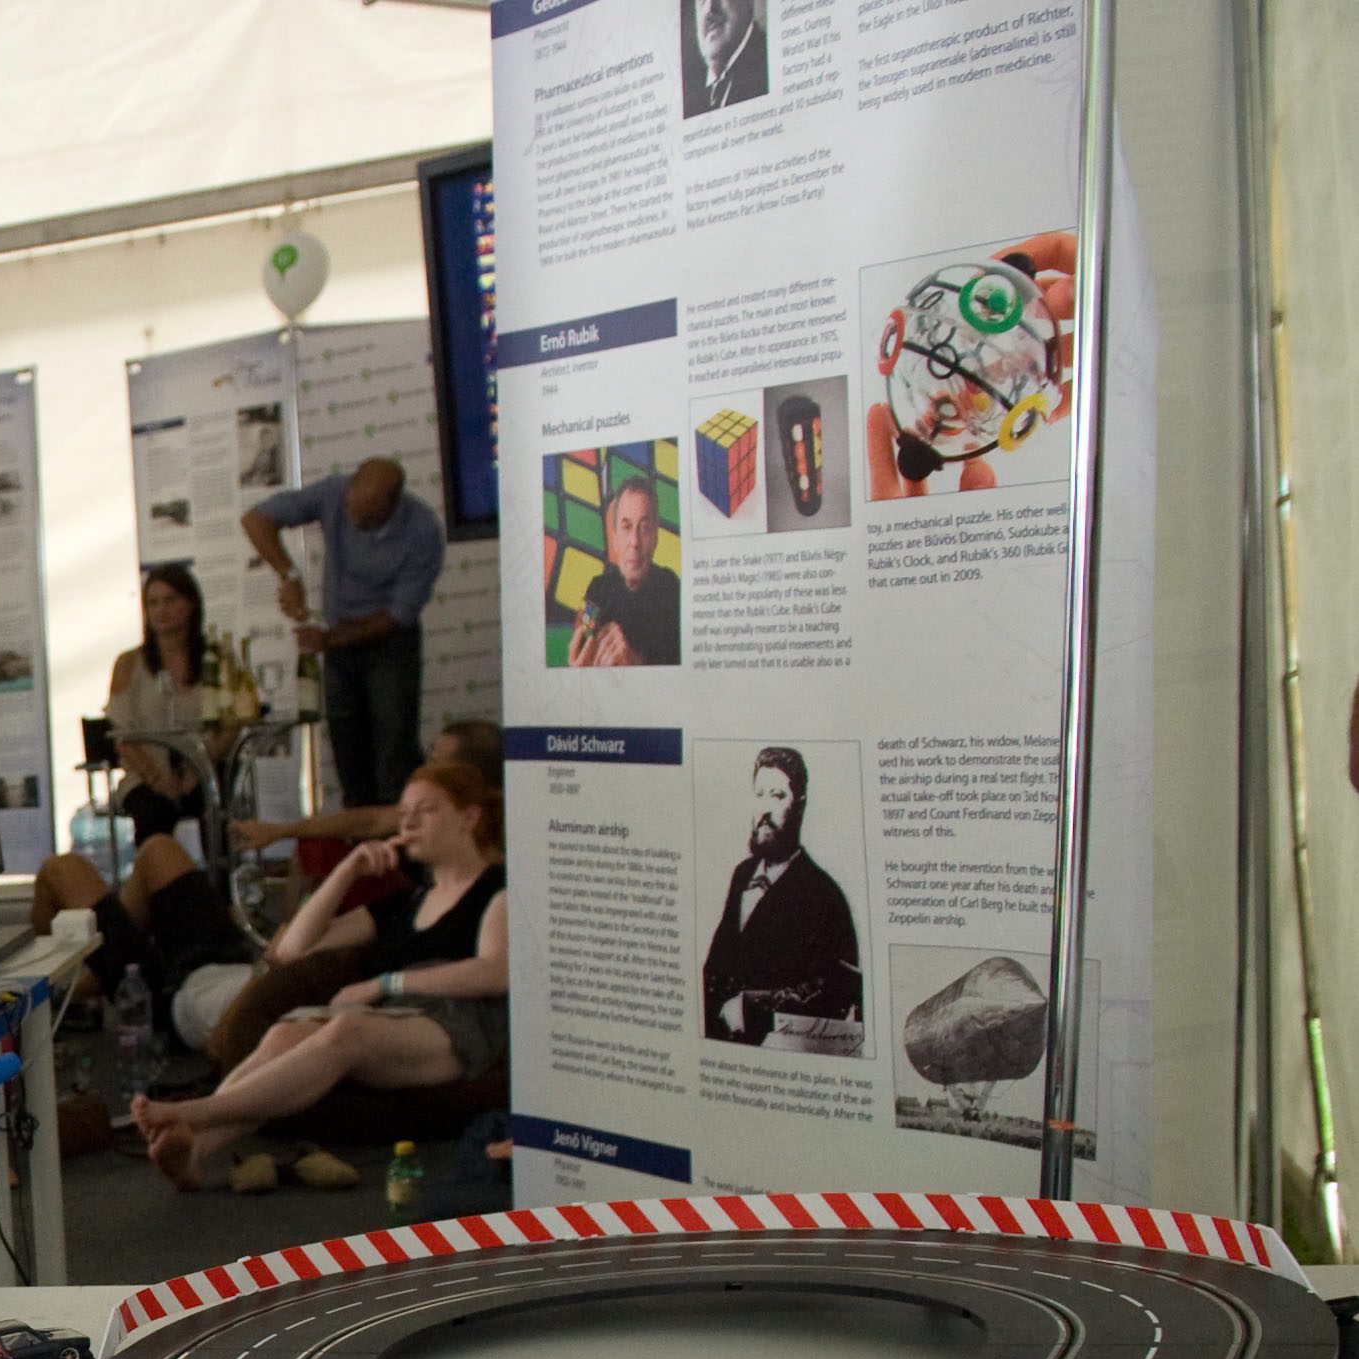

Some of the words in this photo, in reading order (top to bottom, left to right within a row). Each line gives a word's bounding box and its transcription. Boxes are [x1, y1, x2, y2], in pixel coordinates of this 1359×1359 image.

[859, 59, 872, 70] The
[874, 53, 890, 68] first
[964, 20, 1008, 44] product
[1012, 14, 1025, 30] of
[1028, 5, 1074, 25] Richter,
[971, 32, 1038, 61] (adrenaline)
[1042, 32, 1052, 44] is
[1055, 23, 1076, 40] still
[535, 70, 602, 102] Pharmaceutical
[606, 51, 654, 78] inventions
[883, 88, 909, 104] widely
[912, 80, 934, 95] used
[936, 77, 946, 89] in
[949, 67, 992, 86] modern
[995, 52, 1056, 75] medicine.
[775, 303, 788, 314] and
[540, 331, 566, 352] Ernő
[568, 324, 600, 347] Rubik
[542, 415, 594, 436] Mechanical
[597, 411, 631, 432] puzzles
[867, 524, 882, 536] toy,
[894, 514, 953, 531] mechanical
[956, 511, 994, 529] puzzle.
[997, 508, 1013, 521] His
[1016, 506, 1044, 519] other
[868, 540, 903, 553] puzzles
[906, 539, 922, 549] are
[961, 526, 1005, 544] Dominó,
[1008, 524, 1060, 539] Sudokube
[868, 557, 901, 570] Rubik's
[936, 551, 957, 564] and
[962, 548, 998, 562] Rubik's
[1002, 546, 1021, 557] 360
[1023, 542, 1055, 557] (Rubik
[868, 576, 887, 588] that
[890, 576, 917, 586] came
[922, 572, 937, 584] out
[941, 571, 950, 582] in
[953, 568, 983, 581] 2009.
[547, 734, 579, 753] Dávid
[582, 736, 625, 754] Schwarz
[878, 738, 906, 750] death
[908, 737, 919, 748] of
[922, 736, 967, 749] Schwarz,
[970, 736, 984, 747] his
[987, 735, 1021, 748] widow,
[879, 756, 897, 768] ued
[900, 756, 914, 767] his
[917, 756, 943, 766] work
[946, 756, 956, 766] to
[958, 754, 1021, 766] demonstrate
[1023, 754, 1039, 765] the
[880, 774, 896, 785] the
[898, 774, 932, 786] airship
[935, 773, 969, 785] during
[972, 776, 978, 784] a
[980, 772, 998, 784] real
[1000, 773, 1018, 783] test
[1020, 771, 1044, 786] flight.
[881, 790, 911, 802] actual
[913, 789, 954, 802] take-off
[956, 789, 978, 801] took
[981, 789, 1007, 803] place
[1008, 793, 1021, 802] on
[1023, 791, 1038, 802] 3rd
[1040, 792, 1059, 802] Nov
[883, 808, 905, 820] 1897
[908, 808, 927, 819] and
[930, 808, 960, 819] Count
[963, 808, 1011, 820] Ferdinand
[1014, 811, 1031, 820] von
[1033, 809, 1058, 824] Zepp
[549, 819, 596, 835] Aluminum
[598, 821, 629, 839] airship
[883, 826, 920, 837] witness
[923, 825, 934, 837] of
[936, 826, 956, 838] this.
[885, 861, 898, 872] He
[902, 861, 938, 875] bought
[940, 861, 958, 873] the
[960, 862, 1003, 874] invention
[1006, 863, 1027, 876] from
[1030, 864, 1045, 876] the
[886, 877, 927, 890] Schwarz
[929, 880, 949, 890] one
[951, 881, 971, 892] year
[974, 880, 995, 892] after
[998, 881, 1011, 892] his
[1013, 881, 1039, 894] death
[887, 896, 946, 910] cooperation
[949, 897, 958, 908] of
[960, 897, 979, 909] Carl
[981, 898, 1002, 913] Berg
[1005, 901, 1017, 911] he
[1019, 901, 1038, 913] built
[889, 912, 930, 927] Zeppelin
[933, 913, 966, 928] airship.
[553, 1128, 580, 1149] Jenő
[583, 1135, 618, 1158] Vigner
